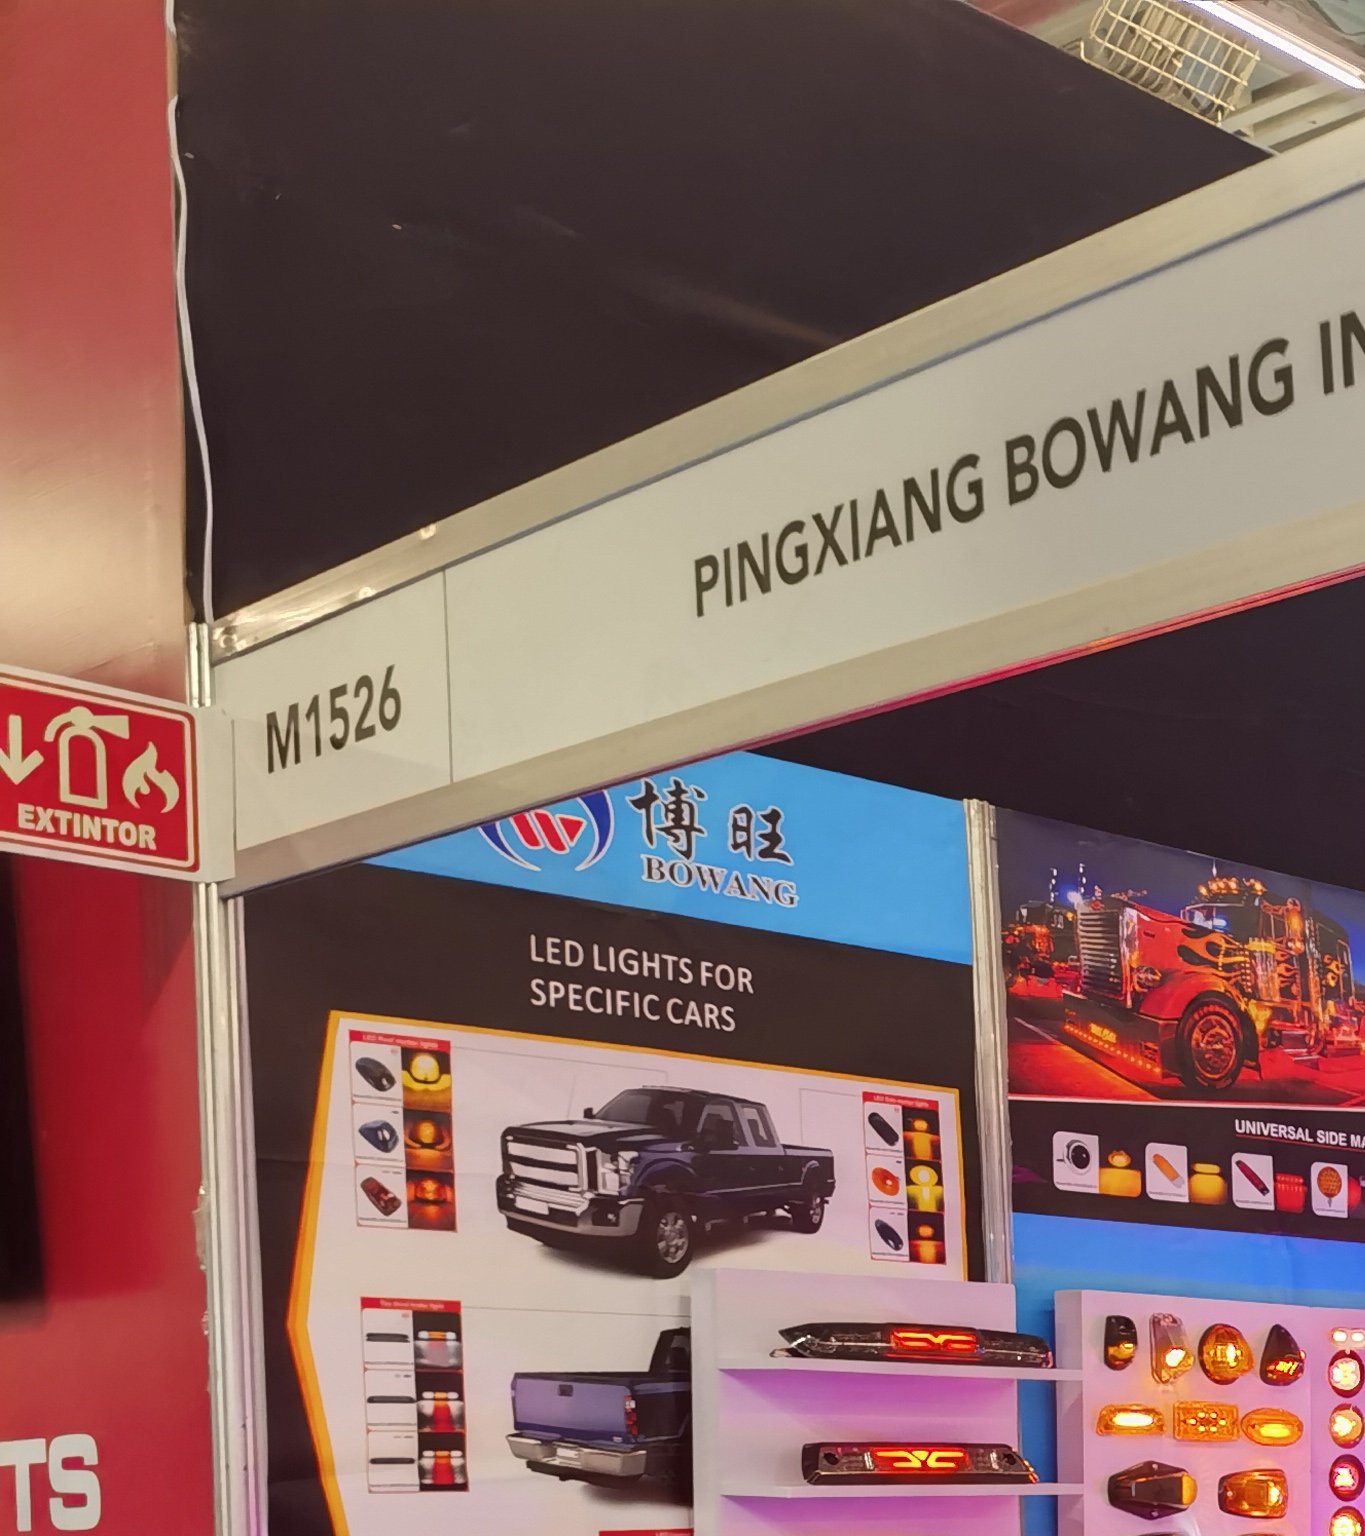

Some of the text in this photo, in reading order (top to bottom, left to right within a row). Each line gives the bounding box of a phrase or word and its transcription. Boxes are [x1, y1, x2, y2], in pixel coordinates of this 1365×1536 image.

[692, 449, 987, 617] PINGXIANG
[1004, 336, 1296, 508] BOWANG
[265, 664, 402, 775] M1526
[17, 802, 157, 851] EXTINTOR
[626, 776, 795, 866] 博旺
[640, 853, 799, 908] BOWANG
[529, 934, 755, 995] LED LIGHTS FOR
[529, 978, 736, 1033] SPECIFIC CARS
[1233, 1118, 1314, 1143] UNIVERSAL
[1316, 1129, 1348, 1147] SIDE
